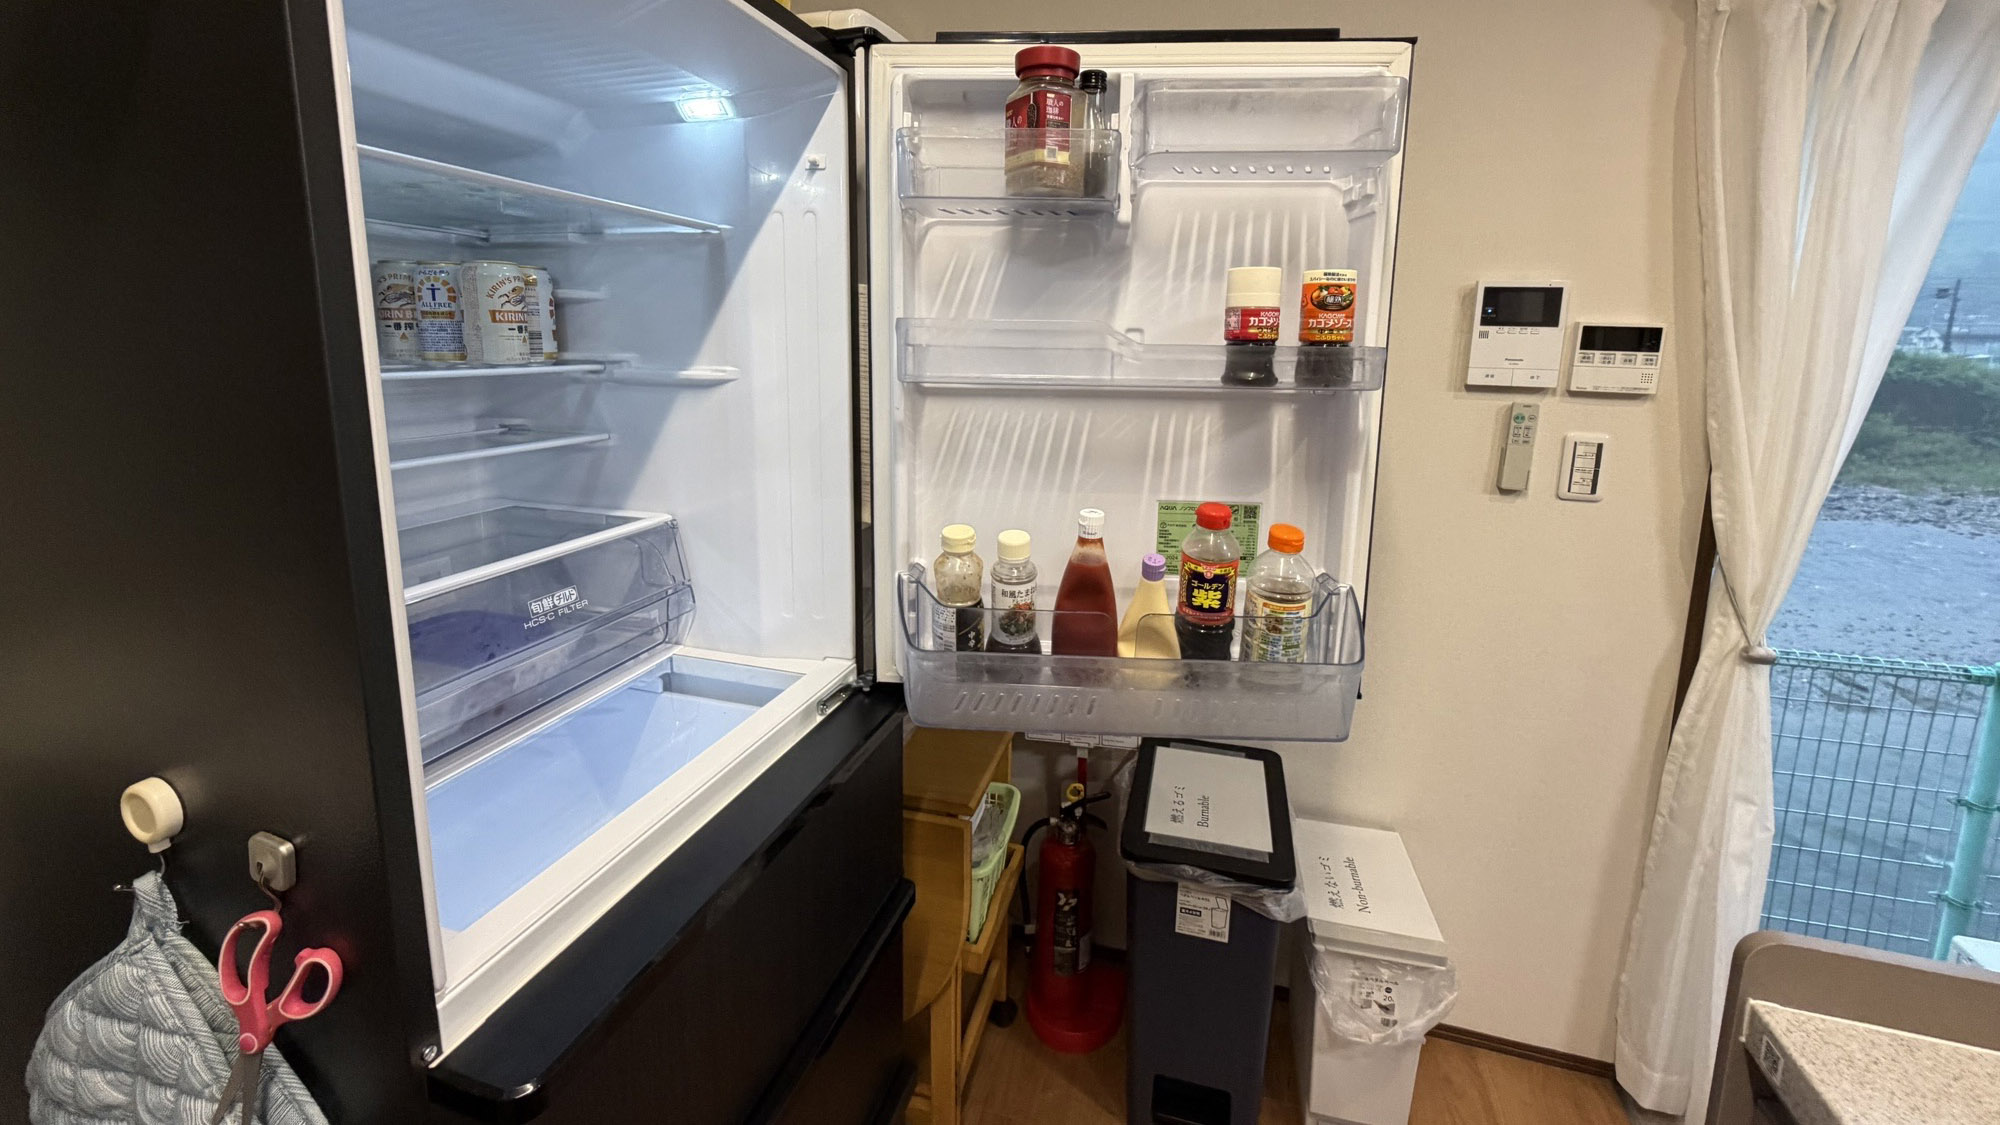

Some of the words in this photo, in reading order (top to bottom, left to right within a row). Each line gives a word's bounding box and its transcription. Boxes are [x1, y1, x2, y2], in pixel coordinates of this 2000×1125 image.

[1308, 319, 1352, 328] カゴメソース
[1191, 580, 1226, 590] ゴールデン
[557, 599, 589, 616] FILTER
[1169, 785, 1186, 825] 燃えるゴミ
[1196, 794, 1210, 828] Burnable
[1318, 856, 1345, 910] 燃えないゴミ
[1342, 856, 1372, 914] Non-burnable
